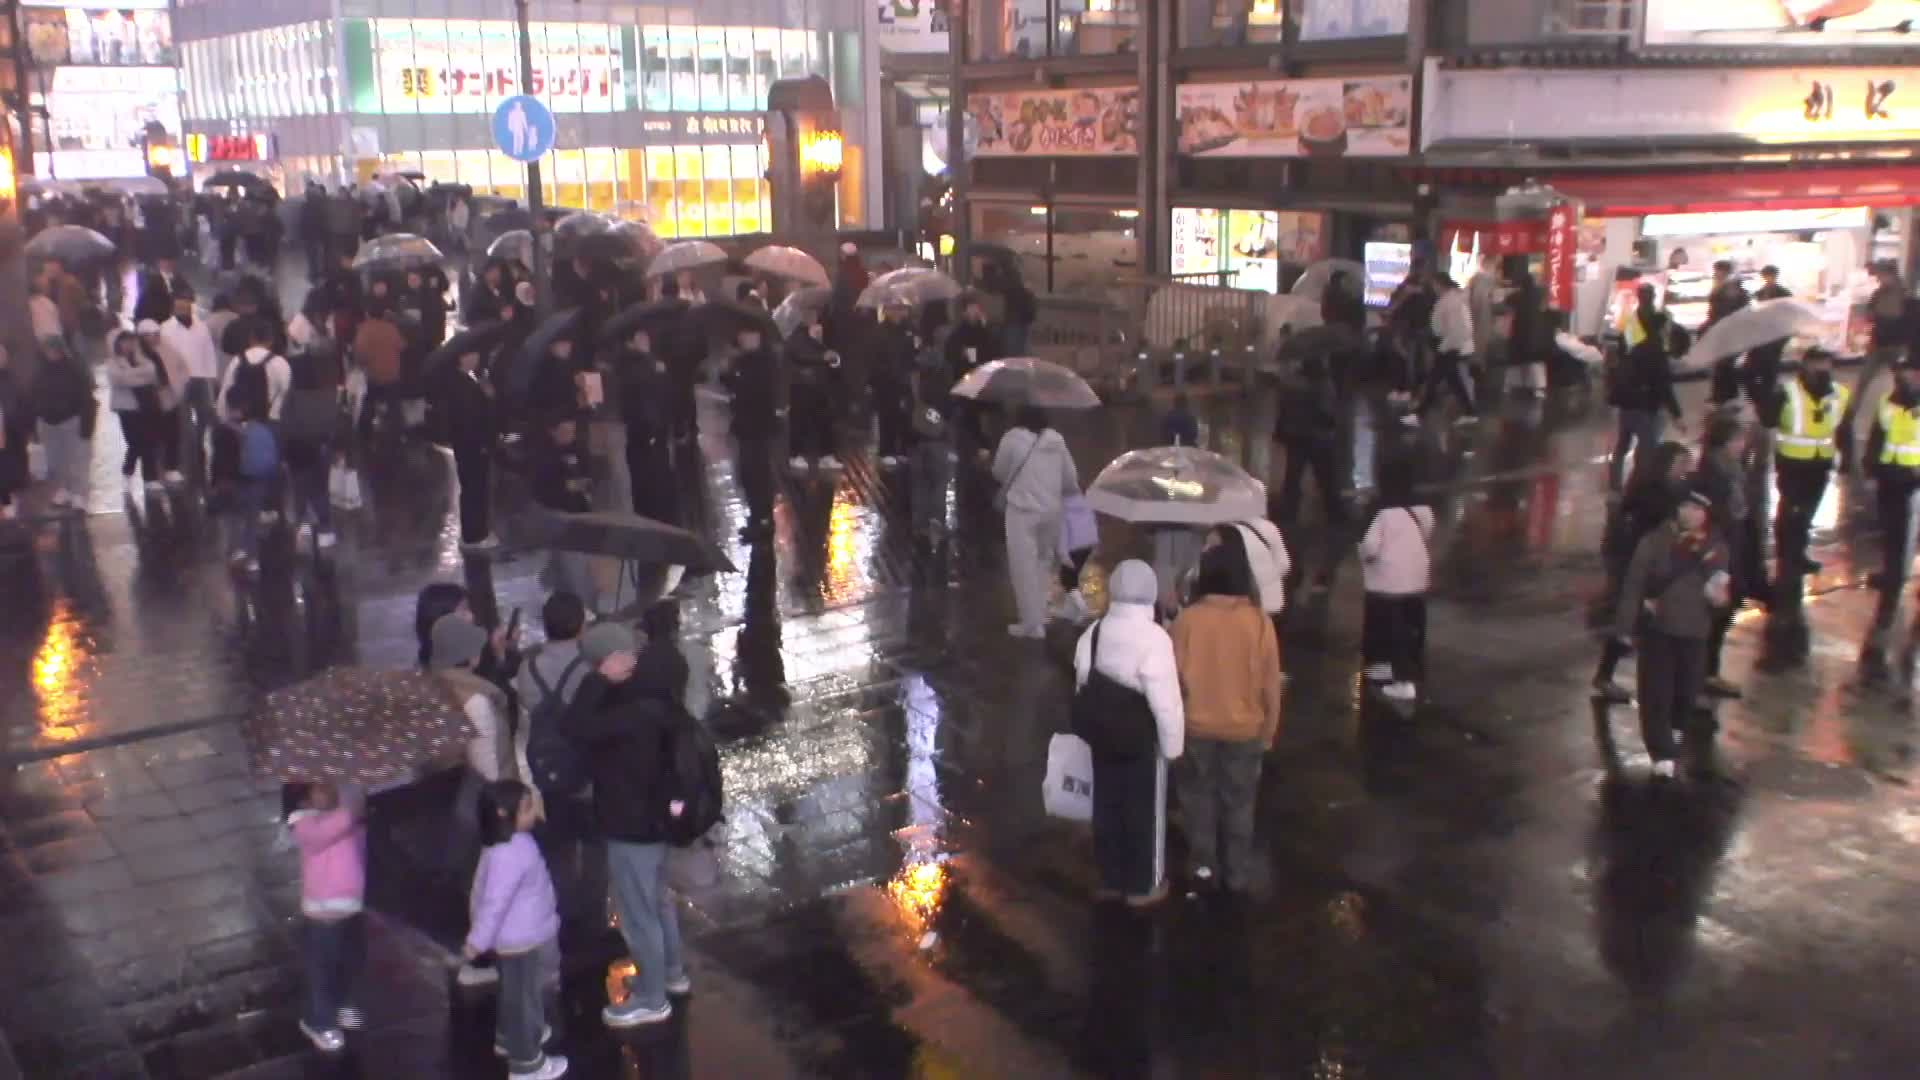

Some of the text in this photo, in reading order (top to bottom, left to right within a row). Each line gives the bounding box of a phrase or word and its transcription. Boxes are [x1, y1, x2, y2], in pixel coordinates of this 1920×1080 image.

[402, 67, 591, 97] 薬 サンドラッグ
[1803, 79, 1896, 120] かに
